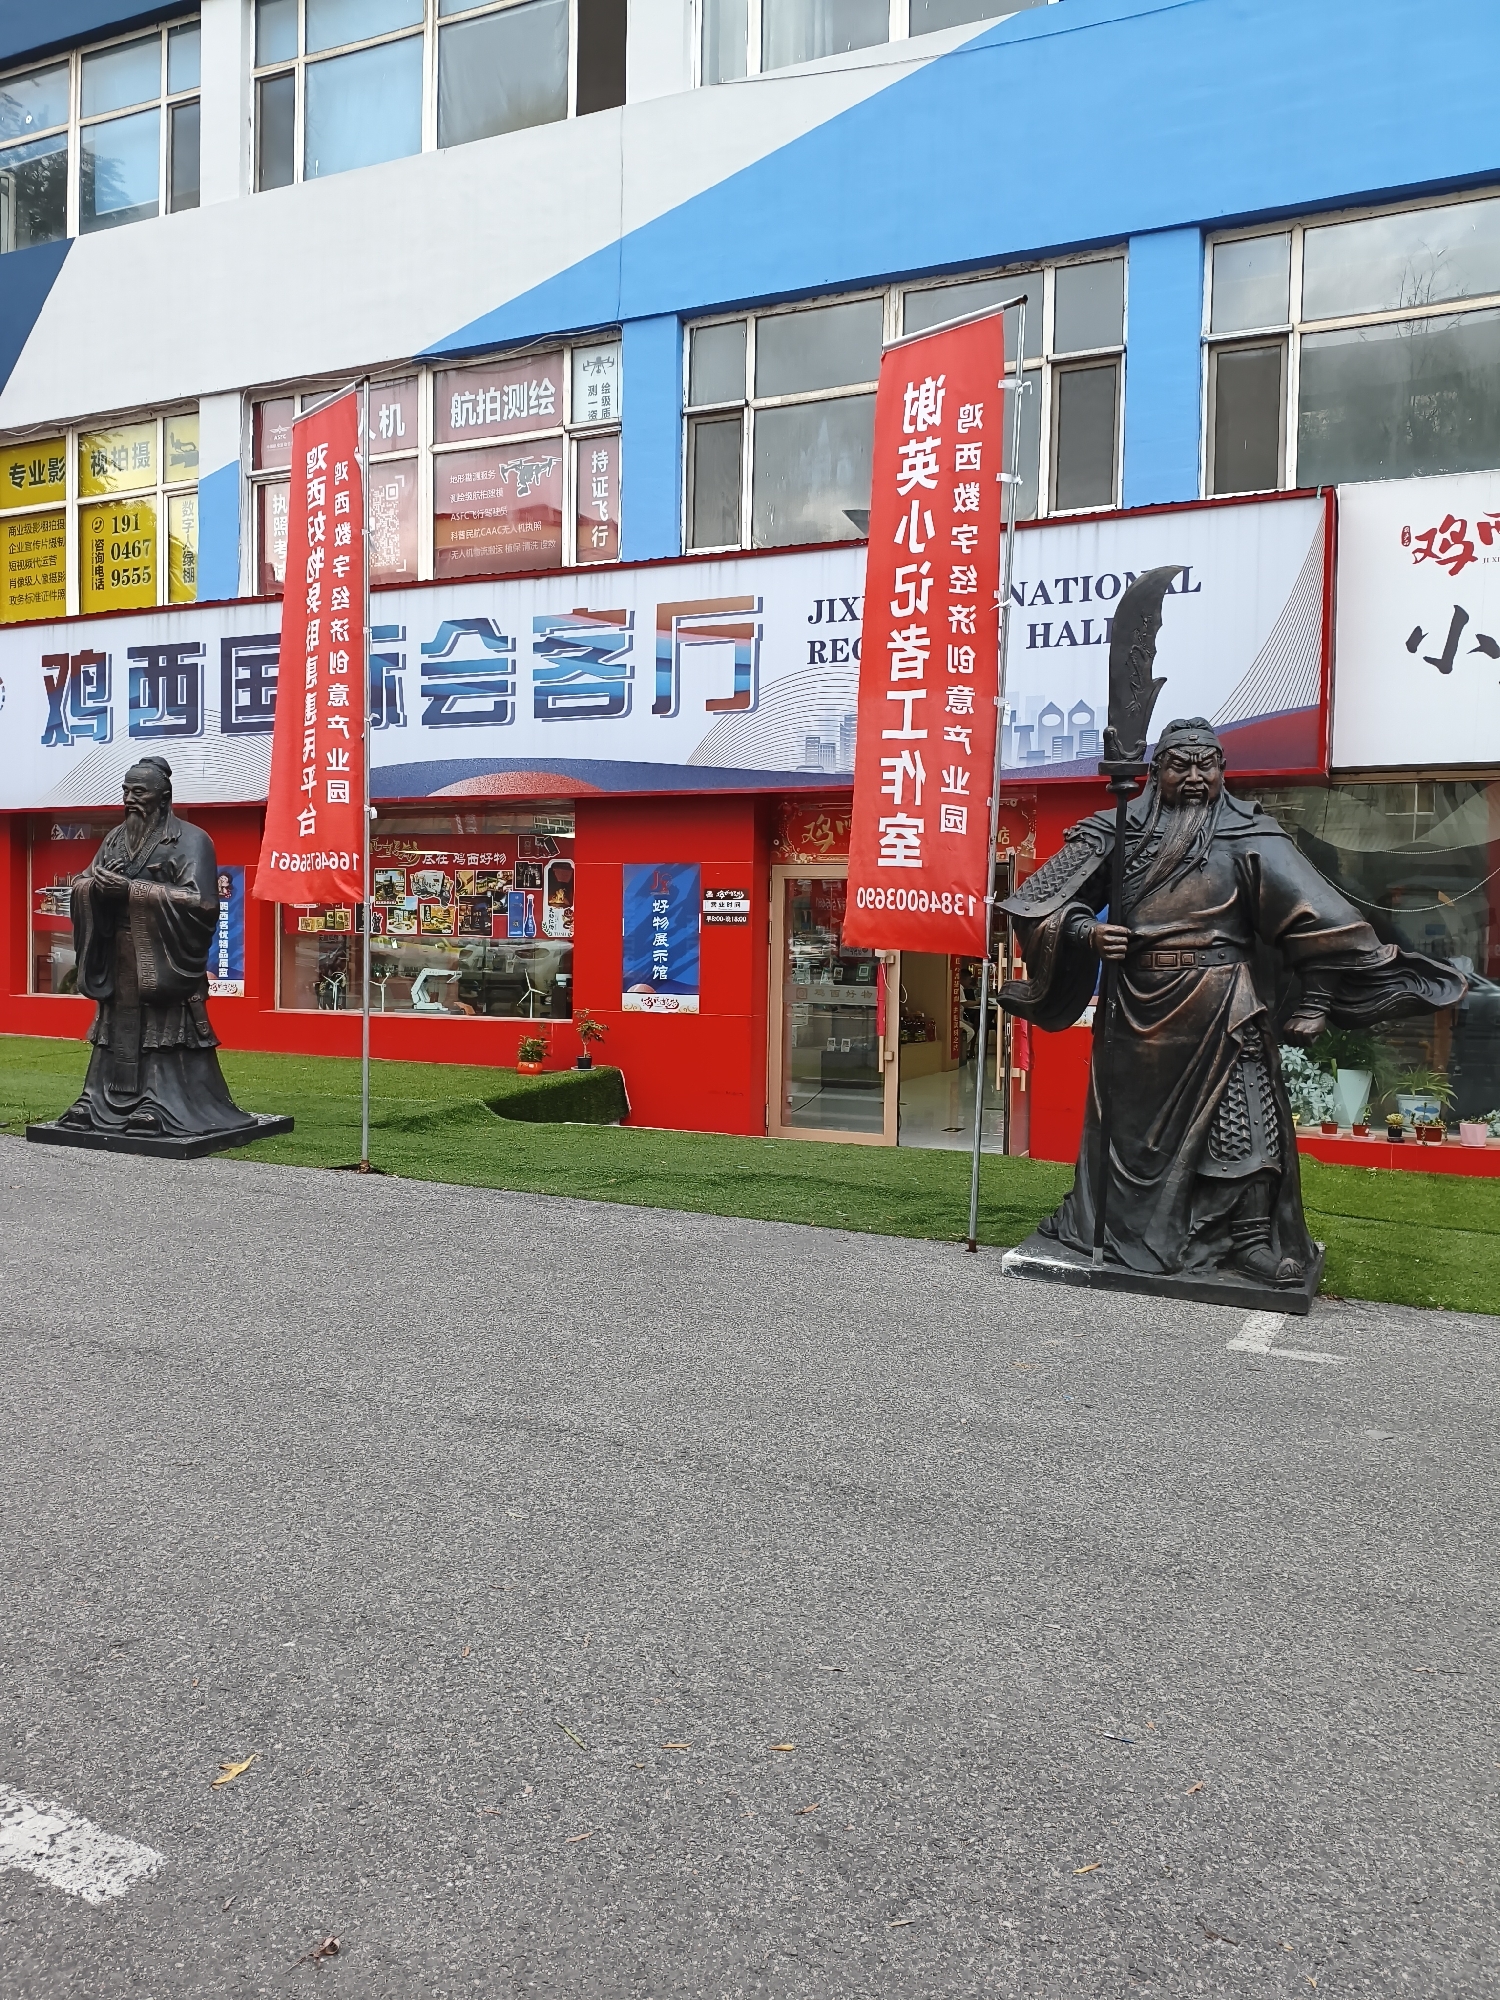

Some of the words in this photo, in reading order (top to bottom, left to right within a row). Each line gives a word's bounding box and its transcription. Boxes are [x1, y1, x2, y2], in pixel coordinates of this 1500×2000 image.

[450, 378, 556, 429] 航拍测绘
[111, 513, 141, 535] 191
[592, 449, 608, 549] 持证飞行
[8, 555, 58, 572] 短视频代运营
[94, 538, 105, 591] 咨询电话
[110, 538, 152, 561] 0467
[182, 500, 195, 584] 数字人绿棚
[111, 565, 152, 588] 9555
[807, 596, 865, 625] JIX
[1010, 566, 1201, 607] NATIOL
[453, 851, 507, 867] 鸡西好物
[652, 899, 671, 980] 好物展示馆
